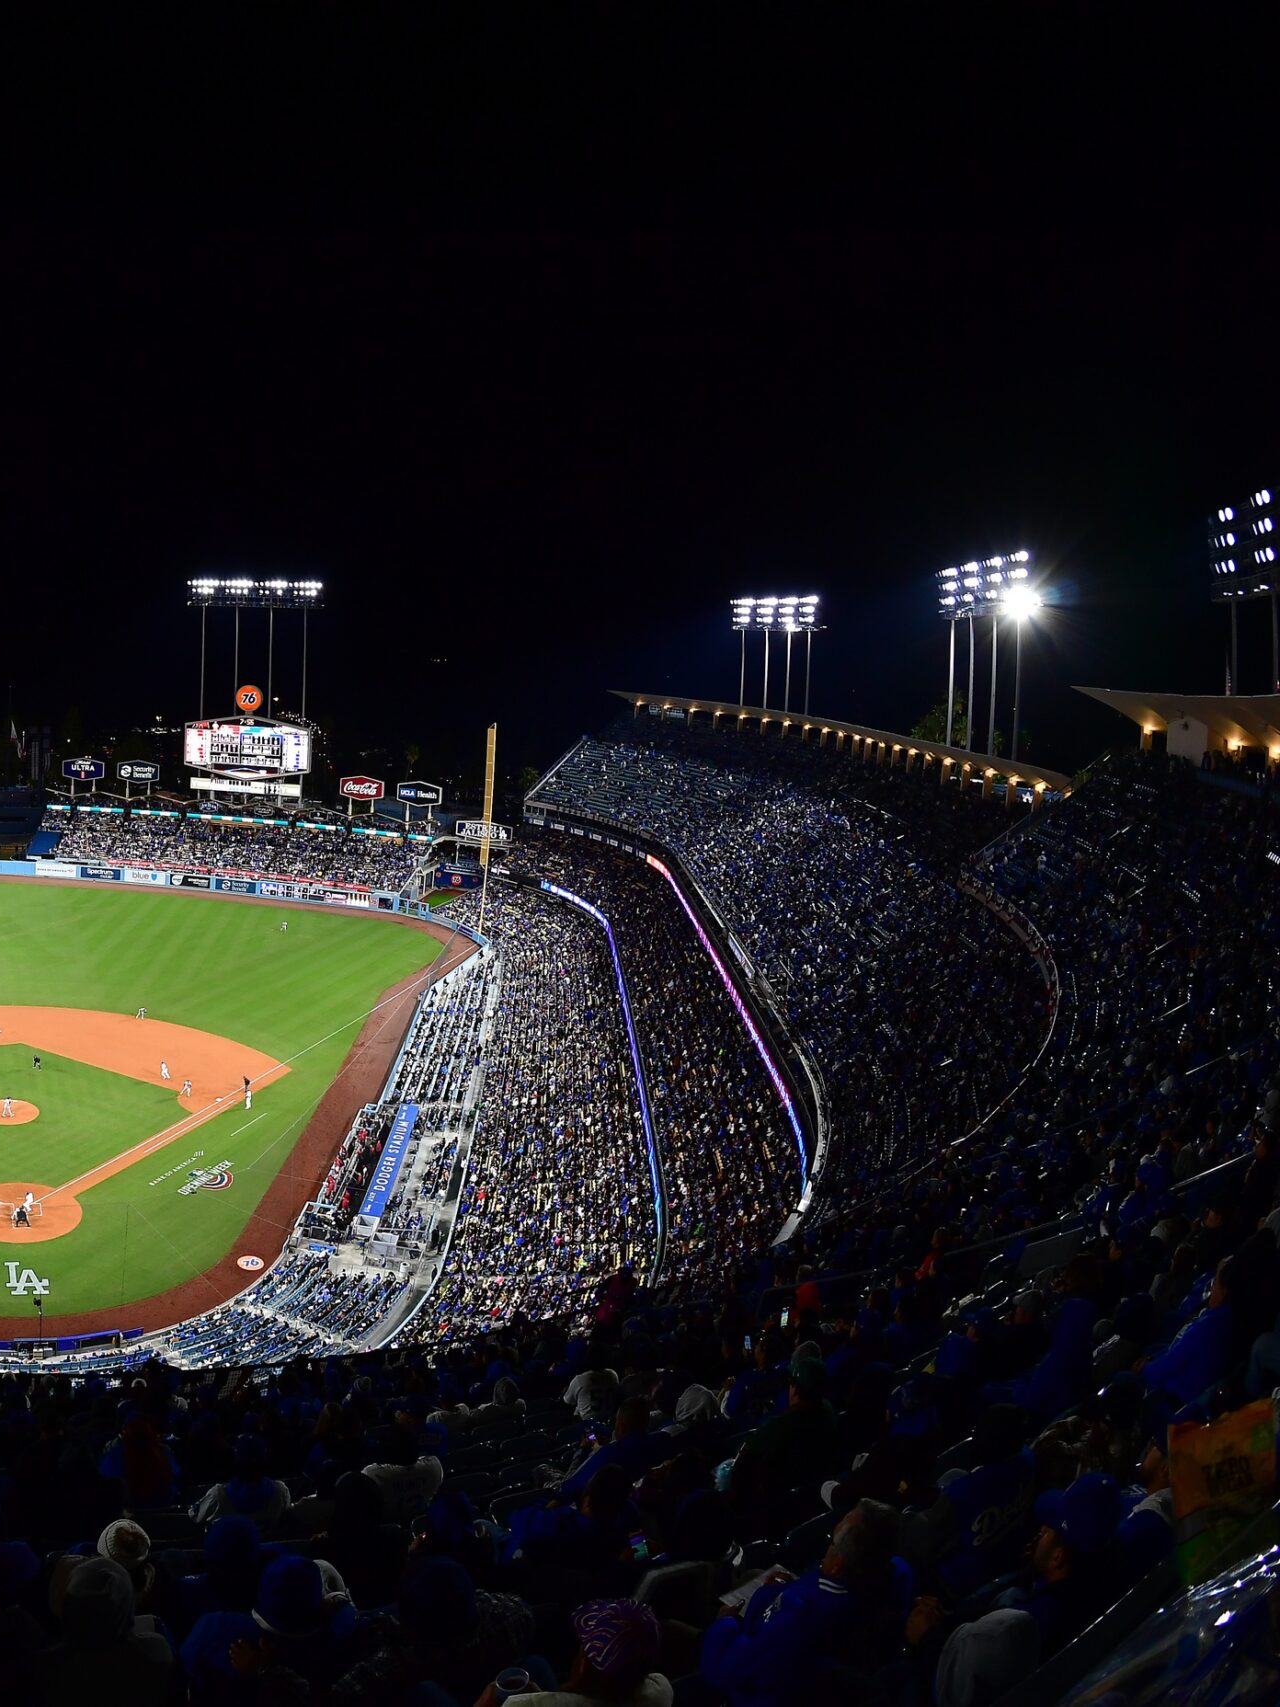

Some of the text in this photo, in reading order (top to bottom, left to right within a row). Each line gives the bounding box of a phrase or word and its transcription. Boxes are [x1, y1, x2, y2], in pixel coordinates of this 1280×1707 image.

[241, 692, 257, 704] 76
[133, 765, 155, 773] Security
[417, 791, 437, 799] Health
[132, 872, 149, 880] blue
[374, 1156, 396, 1192] DODGER
[388, 1121, 409, 1153] STADIUM
[172, 1157, 198, 1173] AMERICA
[178, 1160, 235, 1196] OPENING WEEK
[242, 1258, 259, 1266] 76
[4, 1262, 50, 1295] LA
